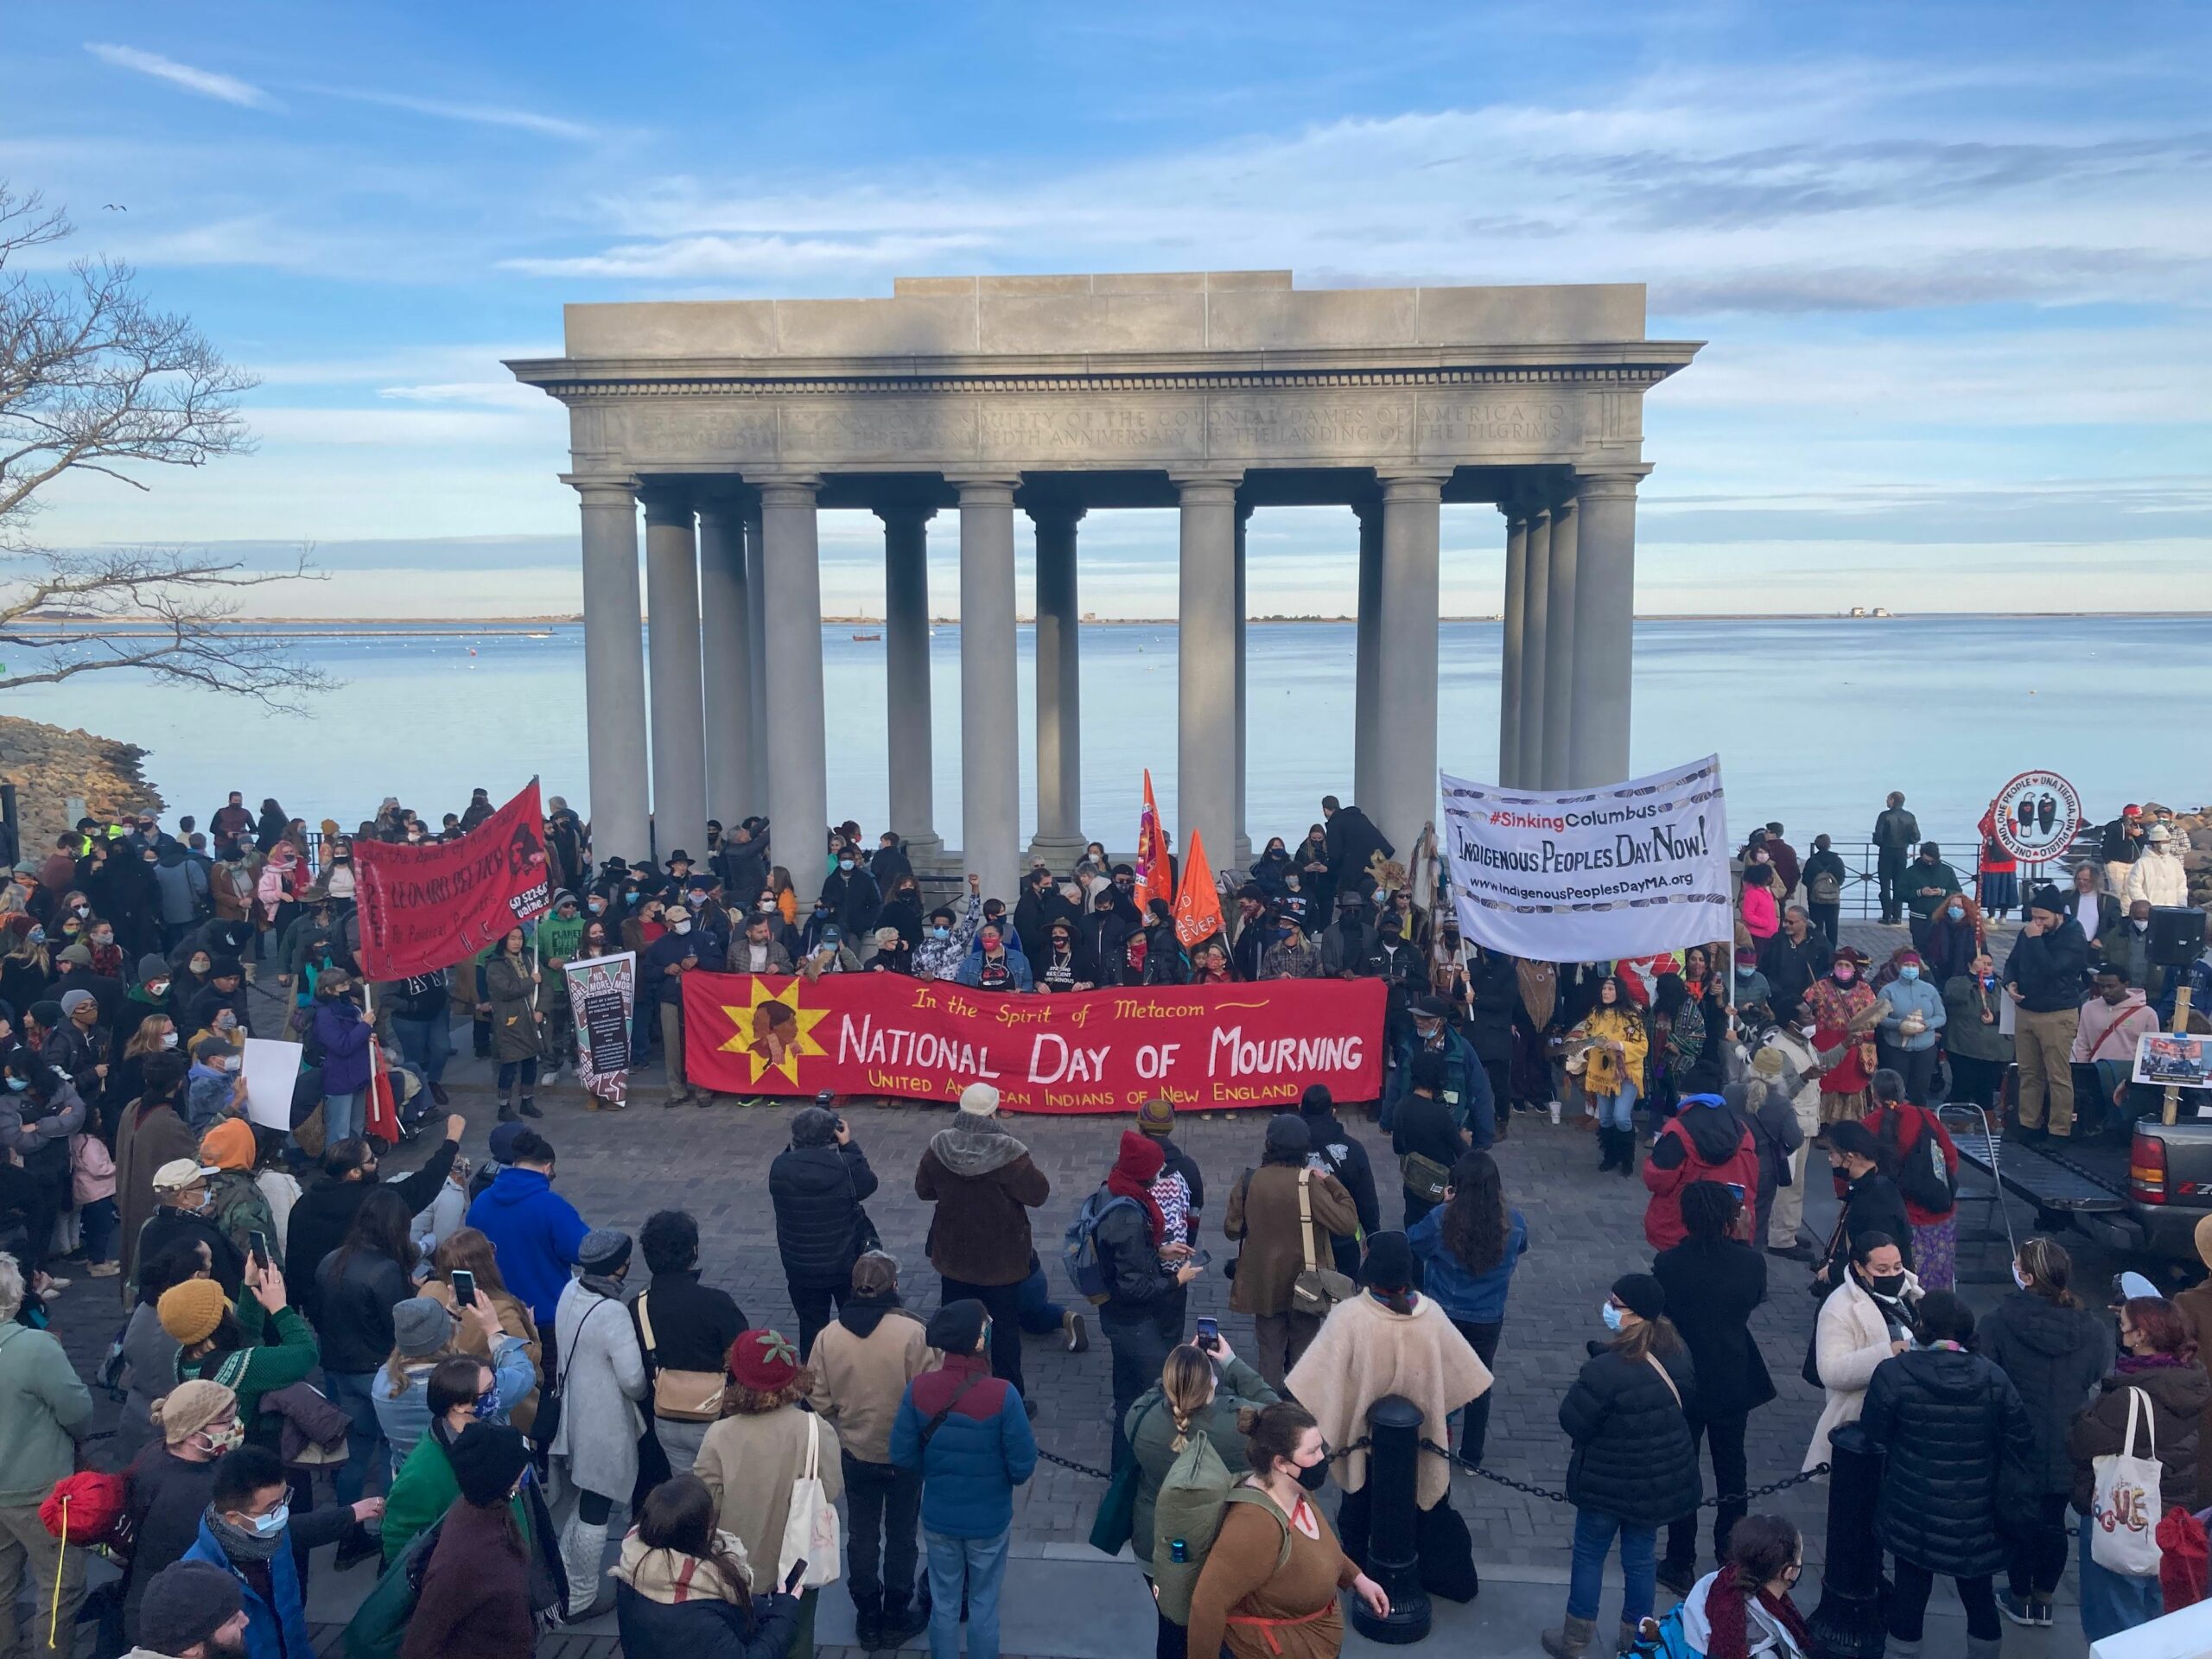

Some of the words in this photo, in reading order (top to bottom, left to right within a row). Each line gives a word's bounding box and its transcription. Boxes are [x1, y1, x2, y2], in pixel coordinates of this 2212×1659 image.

[835, 415, 948, 430] NATIONAL
[962, 413, 1056, 429] SOCIETY
[1066, 412, 1094, 428] OF
[1106, 411, 1147, 427] THE
[1159, 409, 1279, 426] COLONIAL
[1290, 408, 1365, 424] DAMES
[1376, 407, 1405, 423] OF
[1421, 406, 1525, 423] AMERICA
[1534, 404, 1564, 421] TO
[1051, 429, 1187, 446] ANNIVERSARY
[1197, 428, 1223, 443] OF
[1233, 427, 1270, 443] THE
[1280, 425, 1369, 442] LANDING
[1379, 424, 1405, 441] OF
[1416, 423, 1455, 440] THE
[1466, 422, 1562, 439] PILGRIMS
[2003, 778, 2031, 804] PEOPLE
[2040, 776, 2058, 789] UNA
[1997, 804, 2007, 823] ONE
[2057, 784, 2077, 817] TIERRA,
[1999, 823, 2015, 850] LAND,
[2066, 818, 2077, 832] UN
[1456, 825, 1540, 873] INDIGENOUS
[1541, 840, 1614, 874] PEOPLES
[2013, 846, 2031, 858] ONE
[2040, 831, 2070, 858] PUEBLO
[1180, 916, 1217, 943] EVER
[589, 980, 612, 993] MORE
[594, 972, 603, 982] NO
[620, 972, 631, 982] NO
[912, 988, 937, 1009] In
[947, 995, 978, 1019] the
[995, 1003, 1052, 1028] Spirit
[1071, 1003, 1091, 1029] of
[1113, 999, 1205, 1021] Metacom
[837, 1014, 1001, 1079] NATIONAL
[1027, 1033, 1111, 1084] DAY
[1135, 1043, 1181, 1079] OF
[1207, 1025, 1363, 1078] MOURNING
[944, 1077, 1031, 1106] ACAN
[1045, 1089, 1115, 1108] INDIANS
[1127, 1090, 1148, 1105] OF
[1213, 1082, 1299, 1102] ENGLAND
